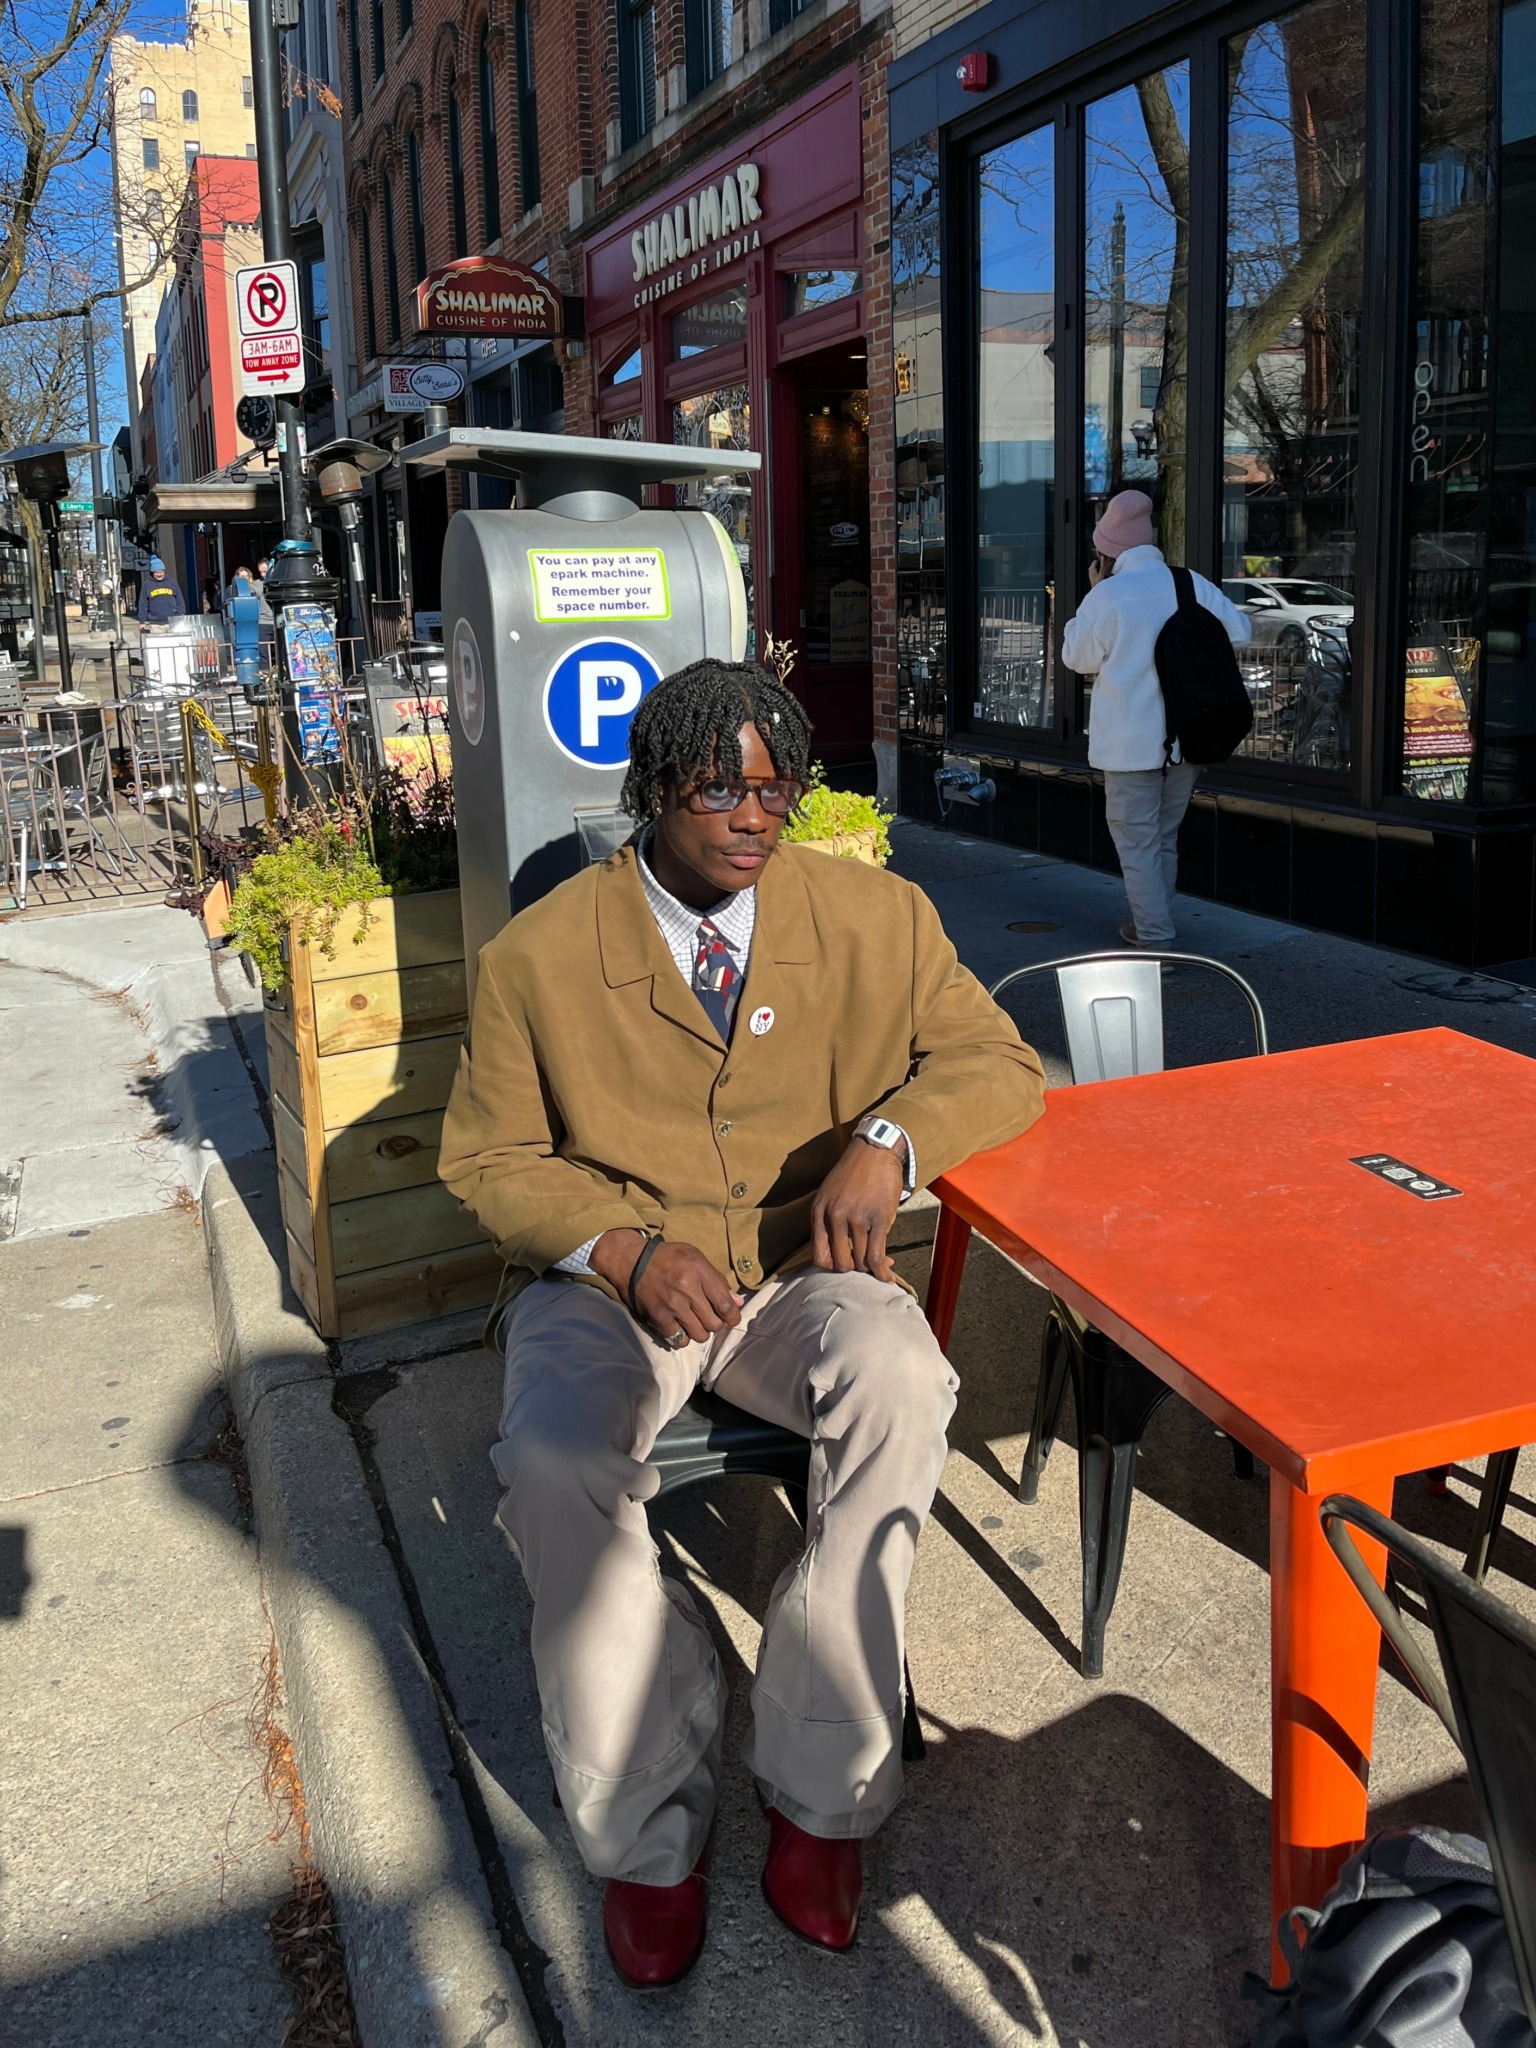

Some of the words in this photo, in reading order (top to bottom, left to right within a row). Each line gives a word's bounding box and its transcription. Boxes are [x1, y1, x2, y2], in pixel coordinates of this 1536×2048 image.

[631, 163, 762, 282] SHALIMAR
[634, 271, 682, 309] CUISINE
[690, 258, 707, 280] OF
[716, 230, 760, 267] INDIA
[258, 282, 279, 318] P
[435, 289, 546, 316] SHALIMAR
[436, 315, 486, 327] CUISINE
[492, 317, 507, 328] OF
[513, 318, 547, 329] INDIA
[249, 338, 293, 356] 3AM-6AM
[245, 358, 259, 369] TOW
[261, 356, 279, 367] AWAY
[281, 354, 298, 365] ZONE
[414, 373, 432, 385] Bitty
[432, 377, 458, 391] Beau's
[536, 556, 561, 565] You
[565, 557, 588, 565] can
[592, 557, 614, 566] pay
[618, 555, 631, 564] at
[635, 556, 656, 566] any
[550, 569, 588, 580] epark
[591, 567, 649, 578] machine.
[551, 585, 621, 597] Remember
[624, 586, 652, 597] your
[556, 602, 595, 614] space
[599, 599, 650, 611] number.
[458, 639, 477, 721] P
[579, 660, 642, 747] P
[757, 1013, 762, 1024] I
[754, 1021, 770, 1033] NY
